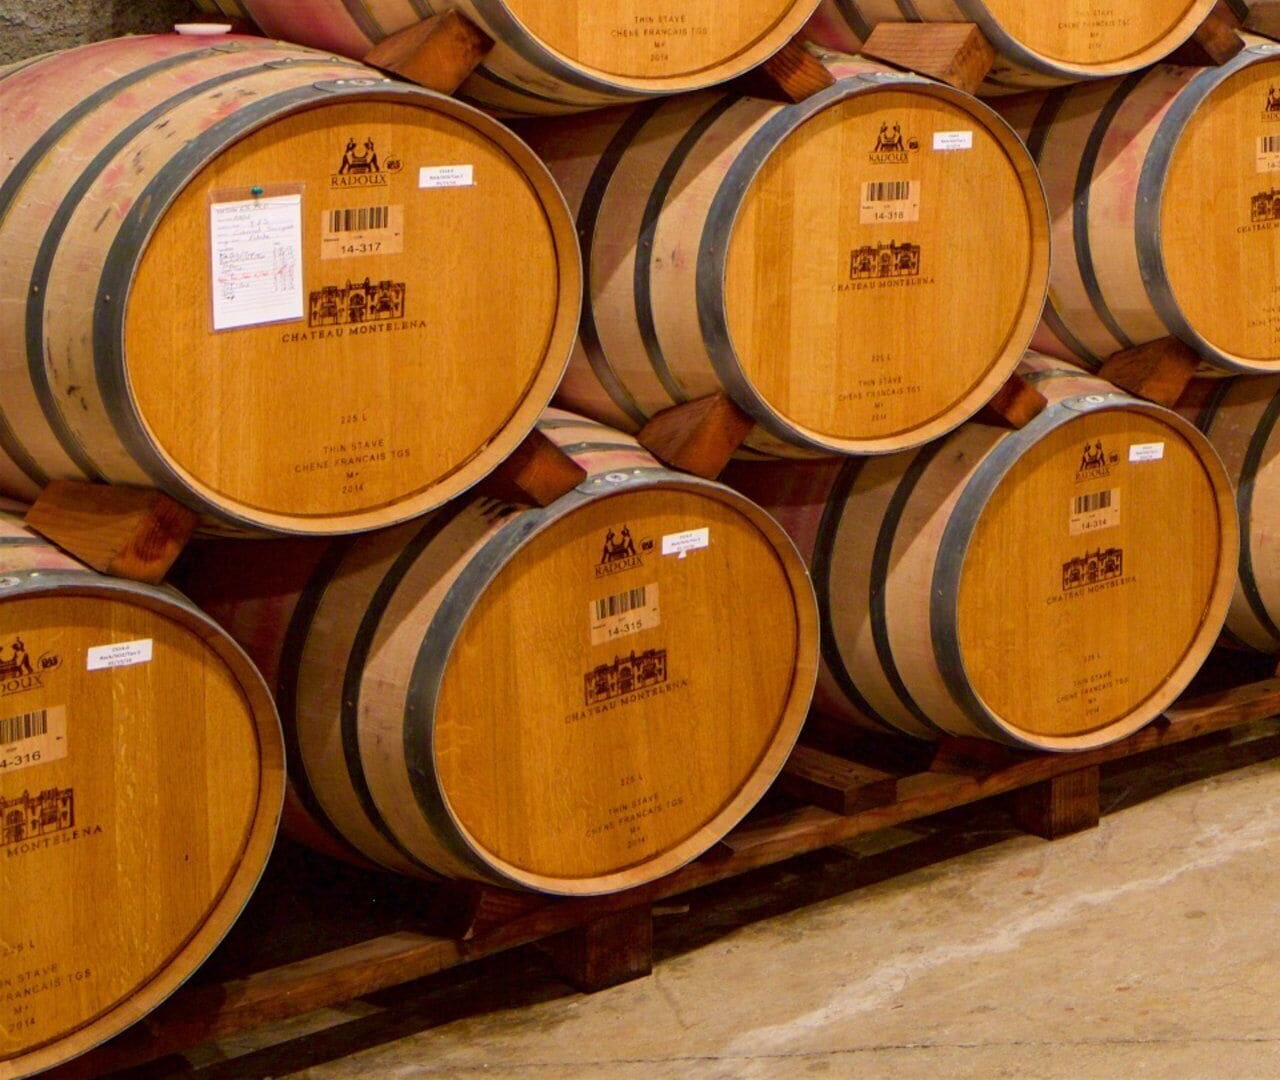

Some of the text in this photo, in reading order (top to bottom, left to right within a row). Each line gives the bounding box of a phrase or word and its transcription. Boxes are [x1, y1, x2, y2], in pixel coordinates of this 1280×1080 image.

[331, 174, 387, 187] RADOUX
[341, 242, 381, 254] 14-317
[282, 320, 427, 344] CHATEAU MONTELENA
[608, 621, 642, 637] 14-315
[7, 823, 103, 858] MONTELENA
